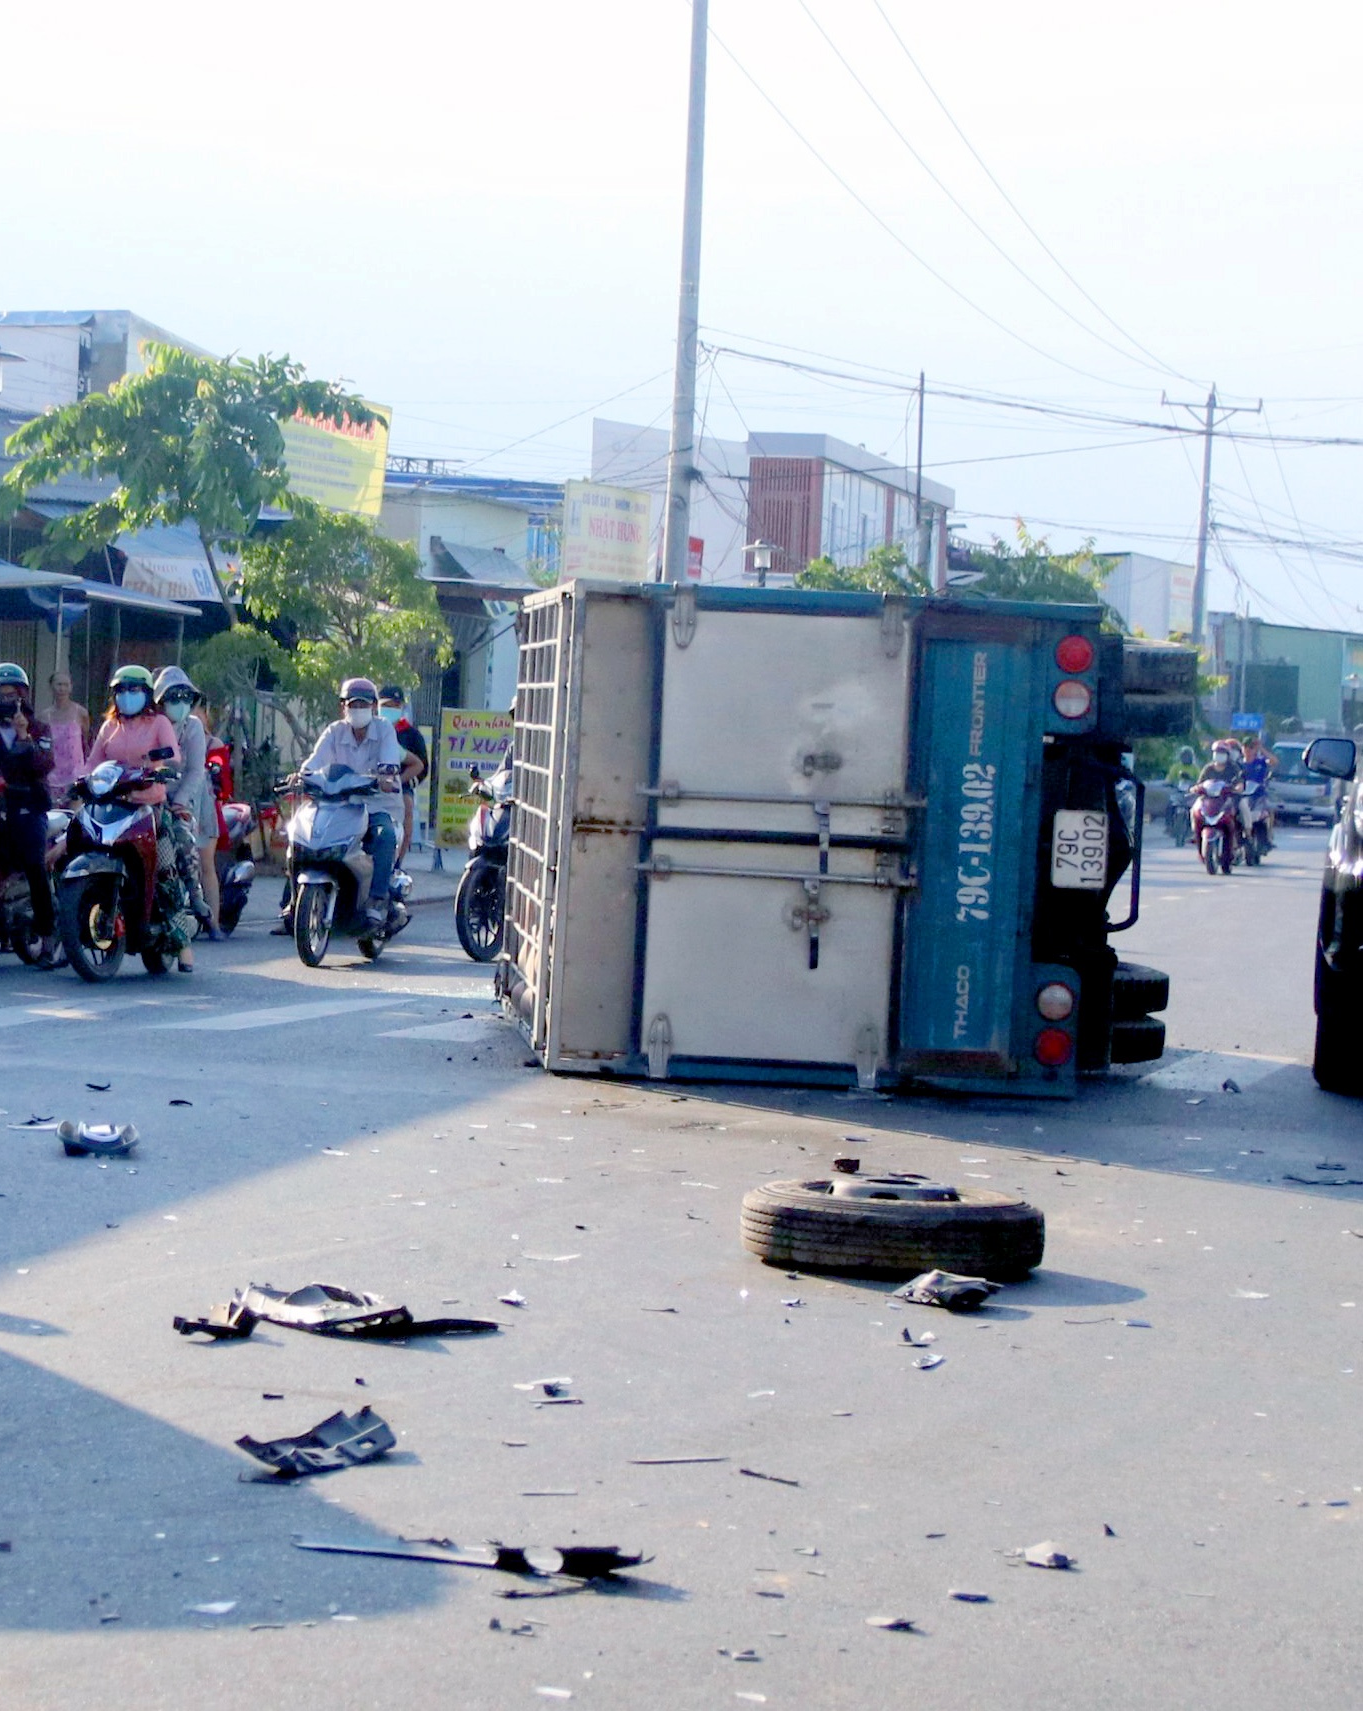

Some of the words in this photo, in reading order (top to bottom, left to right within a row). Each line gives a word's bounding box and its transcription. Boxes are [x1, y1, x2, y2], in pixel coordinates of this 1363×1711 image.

[970, 651, 987, 756] FRONTIER
[1055, 829, 1080, 869] 79C
[1080, 815, 1106, 884] 139.02
[953, 964, 970, 1039] THACO
